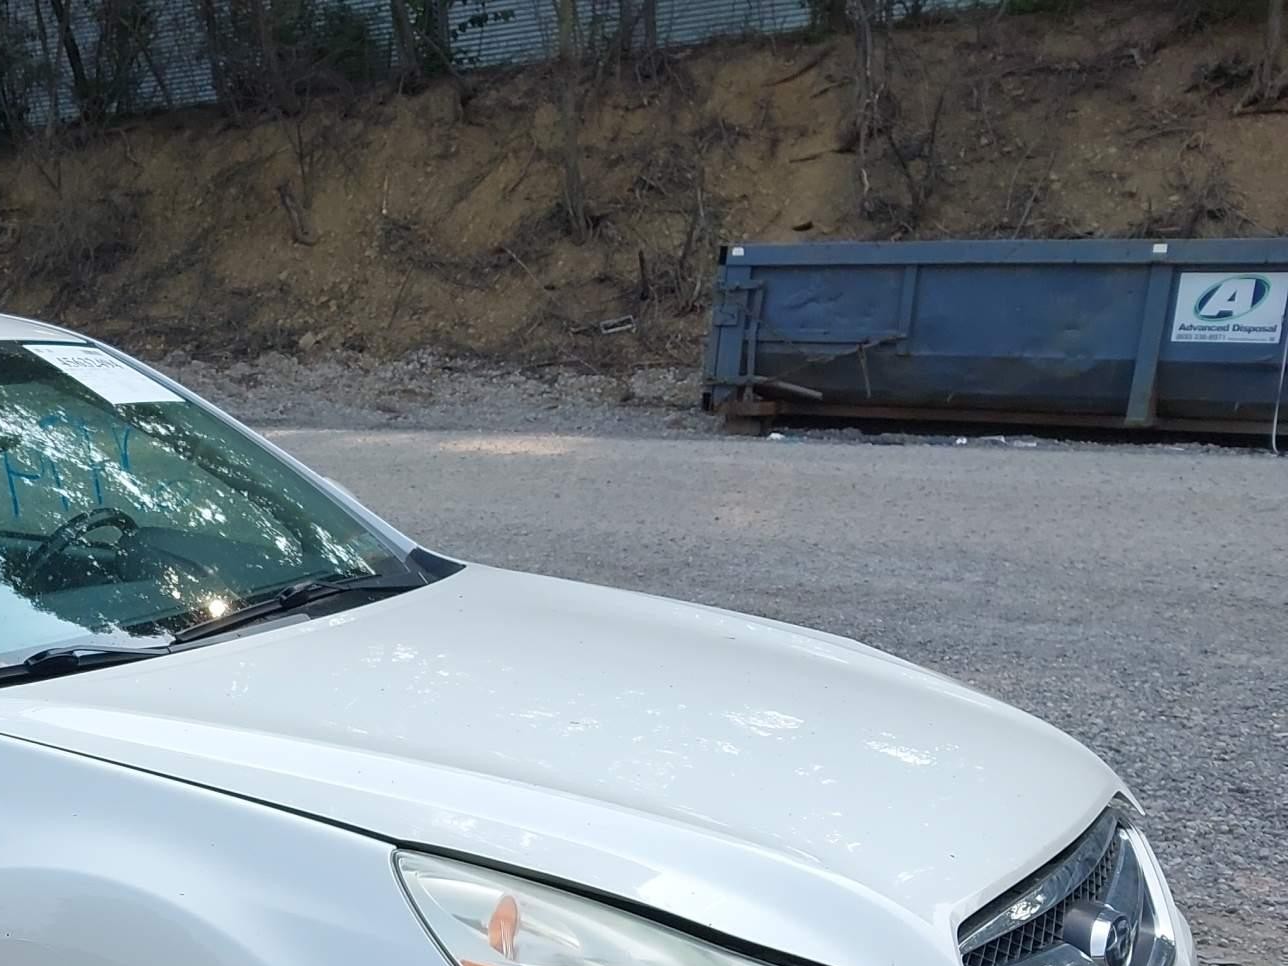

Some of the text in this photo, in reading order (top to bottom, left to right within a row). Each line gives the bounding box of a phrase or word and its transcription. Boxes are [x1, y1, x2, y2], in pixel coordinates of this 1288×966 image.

[1199, 278, 1257, 317] A
[1178, 323, 1277, 334] Advanced Disposal
